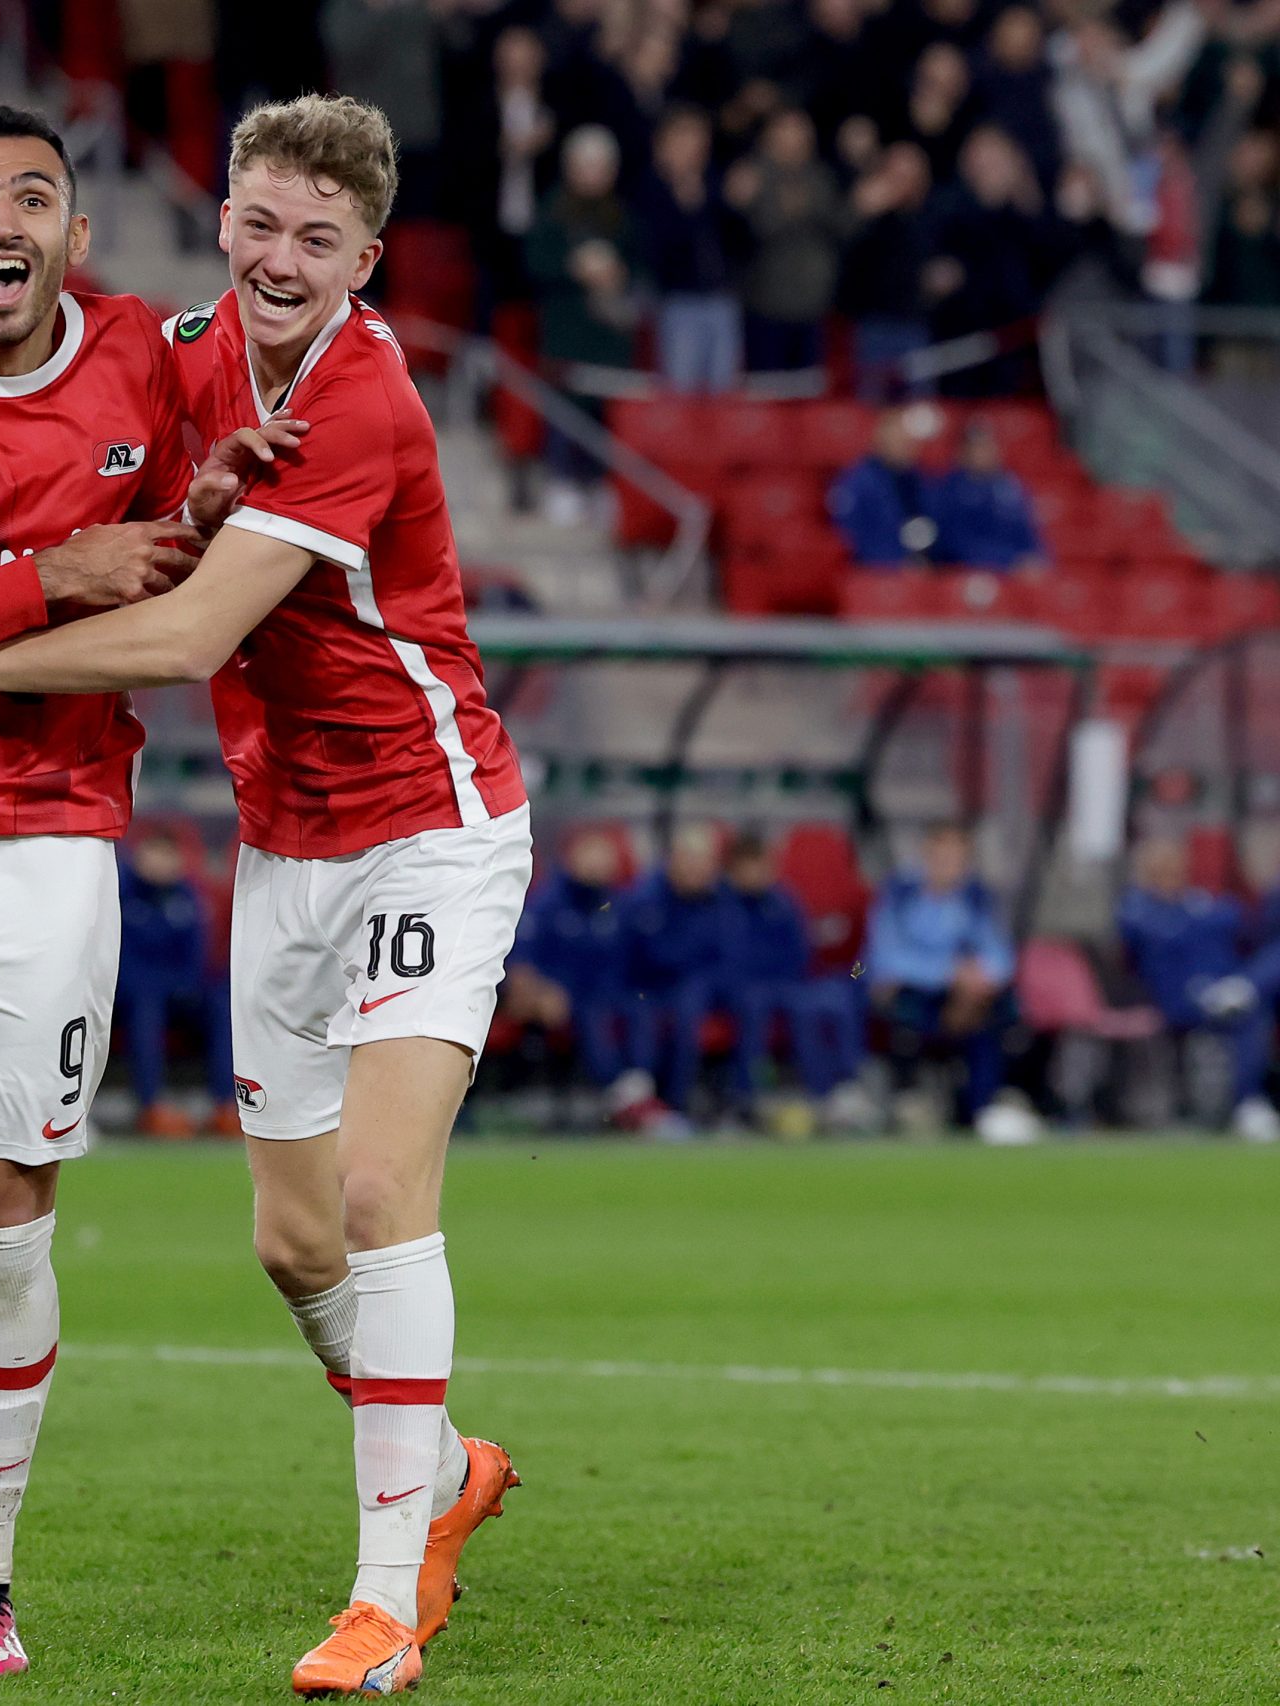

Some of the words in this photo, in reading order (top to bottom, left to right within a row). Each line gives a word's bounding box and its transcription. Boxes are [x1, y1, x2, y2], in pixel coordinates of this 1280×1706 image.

[105, 445, 136, 470] AZ
[367, 912, 435, 981] 16
[60, 1015, 87, 1106] 9
